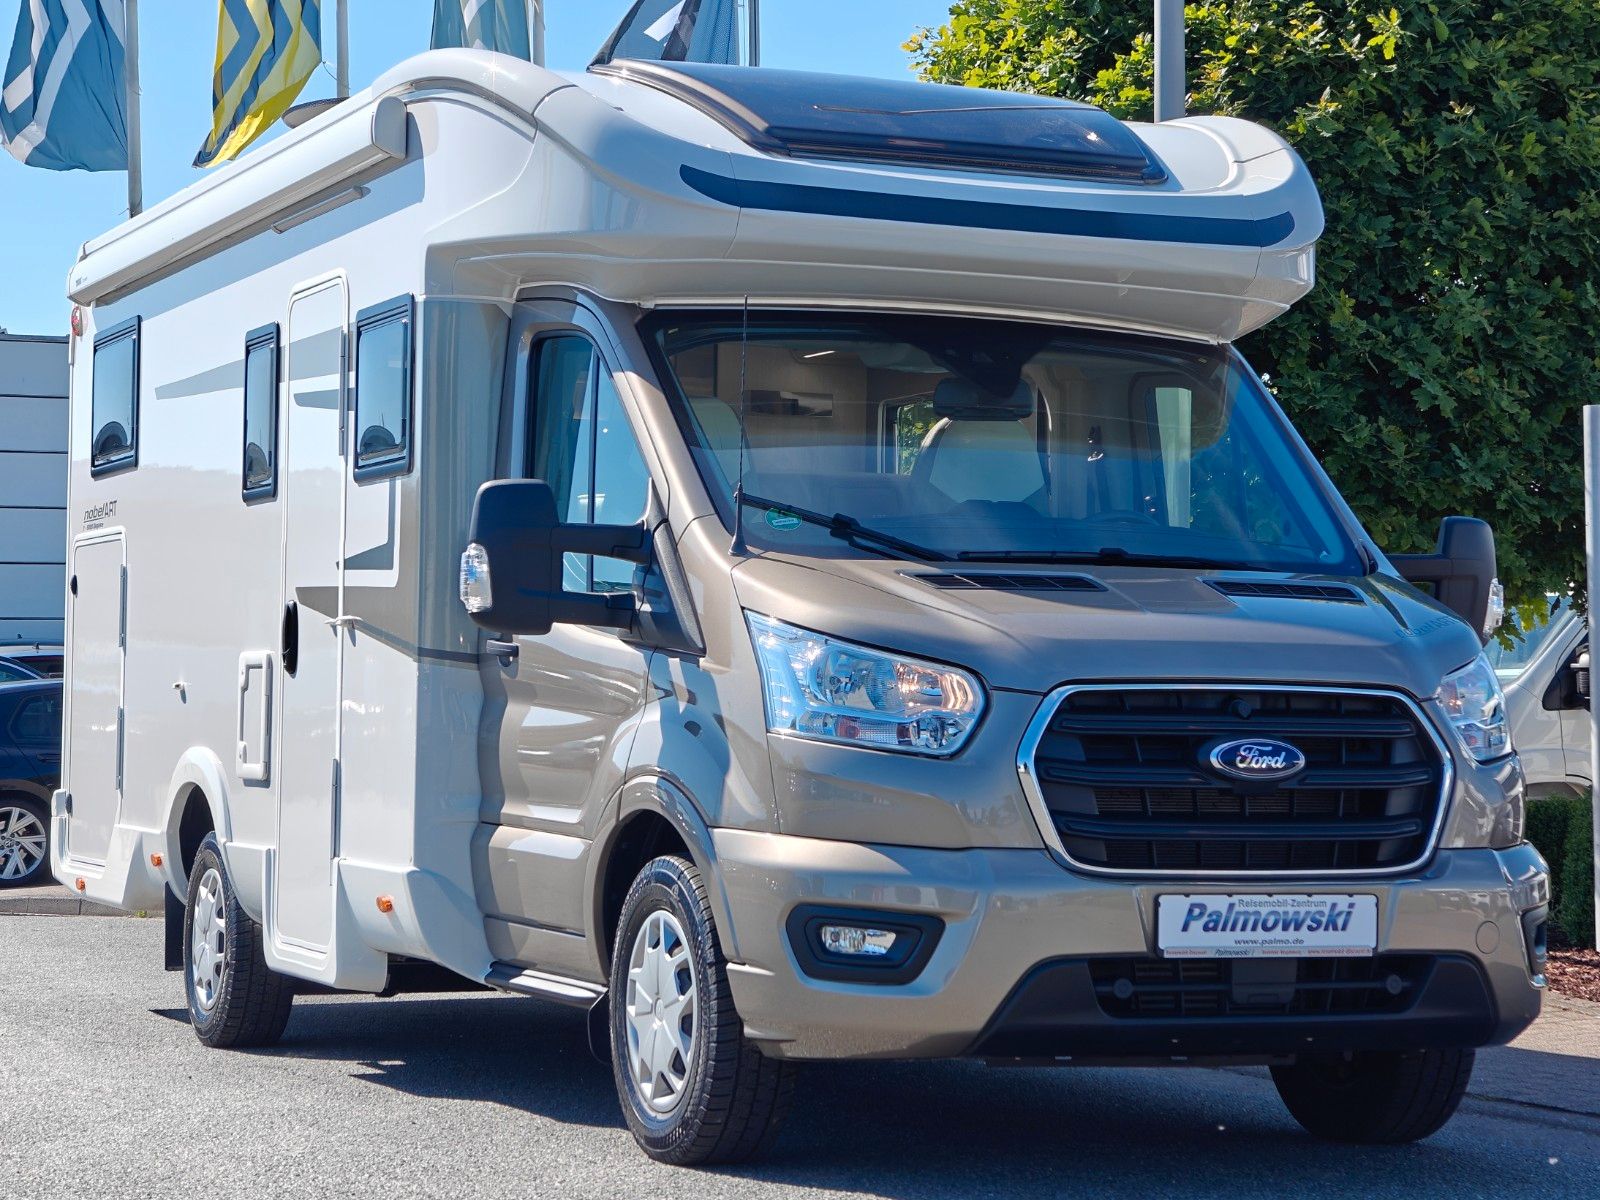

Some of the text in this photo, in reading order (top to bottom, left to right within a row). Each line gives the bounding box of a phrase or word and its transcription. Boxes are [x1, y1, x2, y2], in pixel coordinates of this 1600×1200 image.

[1235, 744, 1286, 768] Ford
[1238, 898, 1327, 908] Reisemobil-Zentrum
[1181, 903, 1355, 932] Palmowski
[1234, 938, 1304, 947] www.palmo.de
